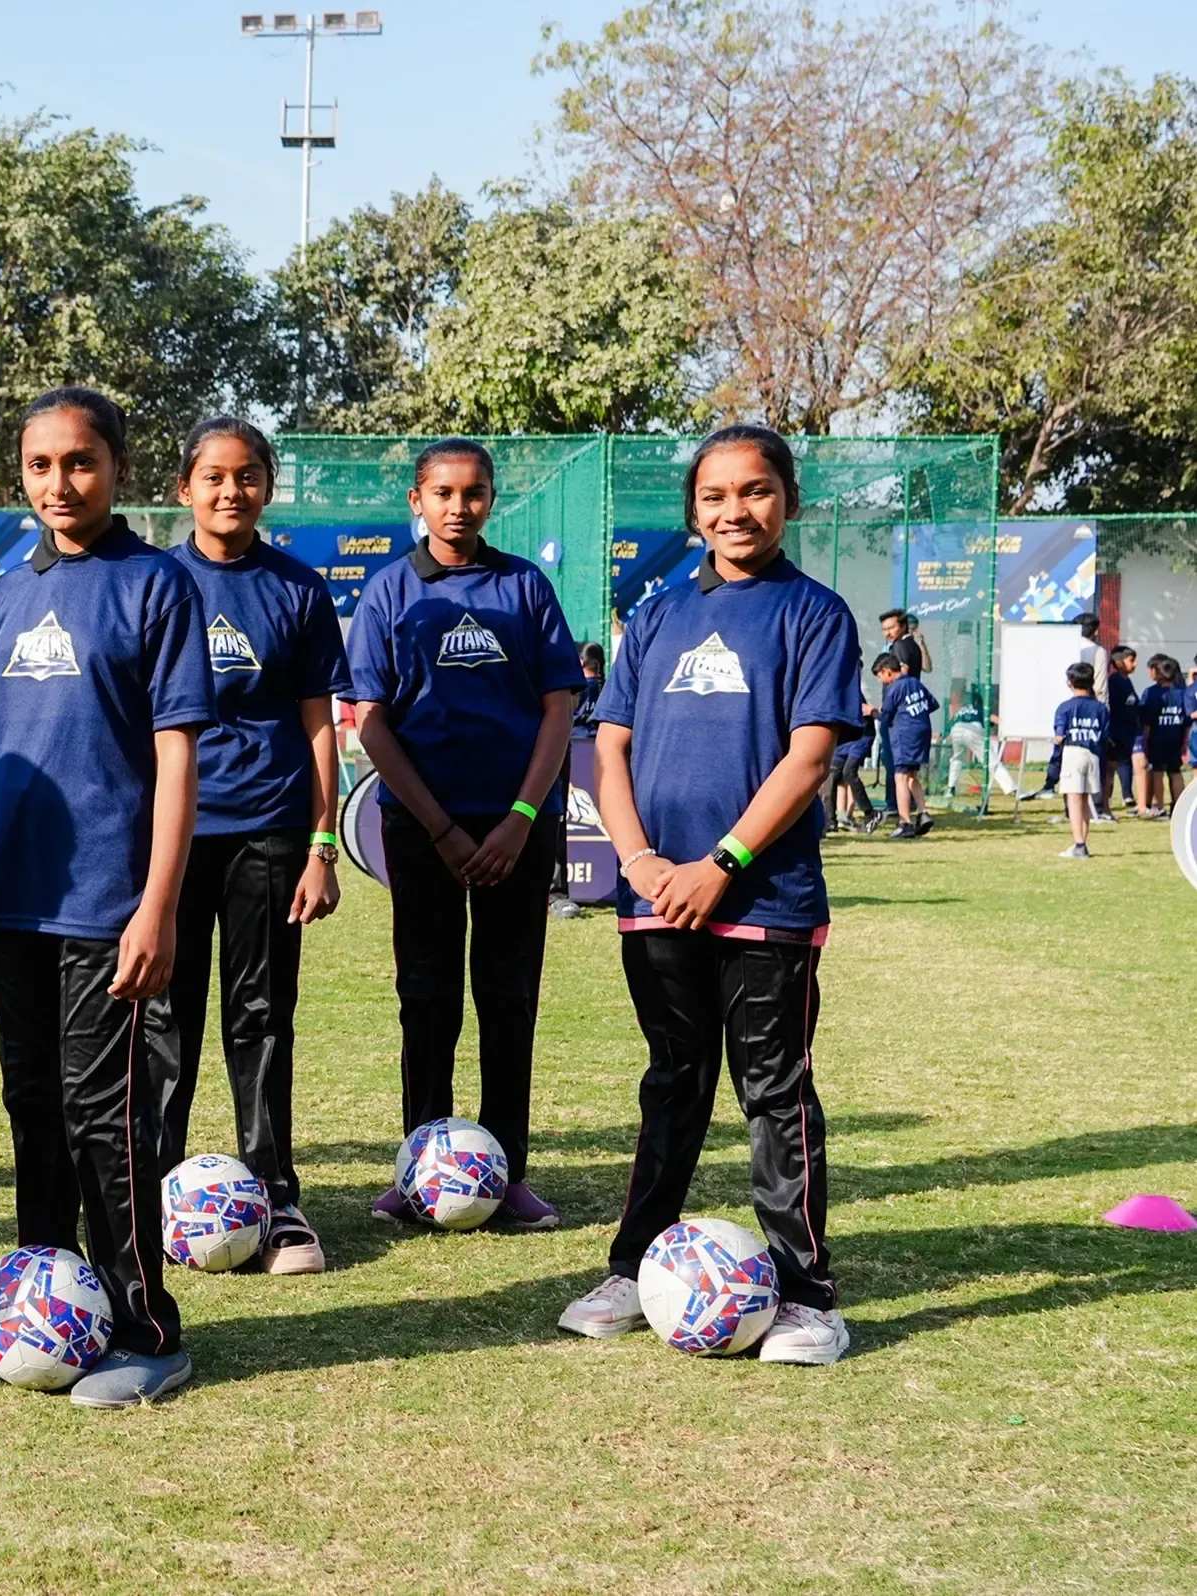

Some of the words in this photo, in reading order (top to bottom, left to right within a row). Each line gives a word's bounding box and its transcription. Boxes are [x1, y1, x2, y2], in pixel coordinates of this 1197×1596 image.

[540, 541, 555, 562] 4
[208, 631, 255, 658] TANS
[441, 629, 501, 655] TITANS
